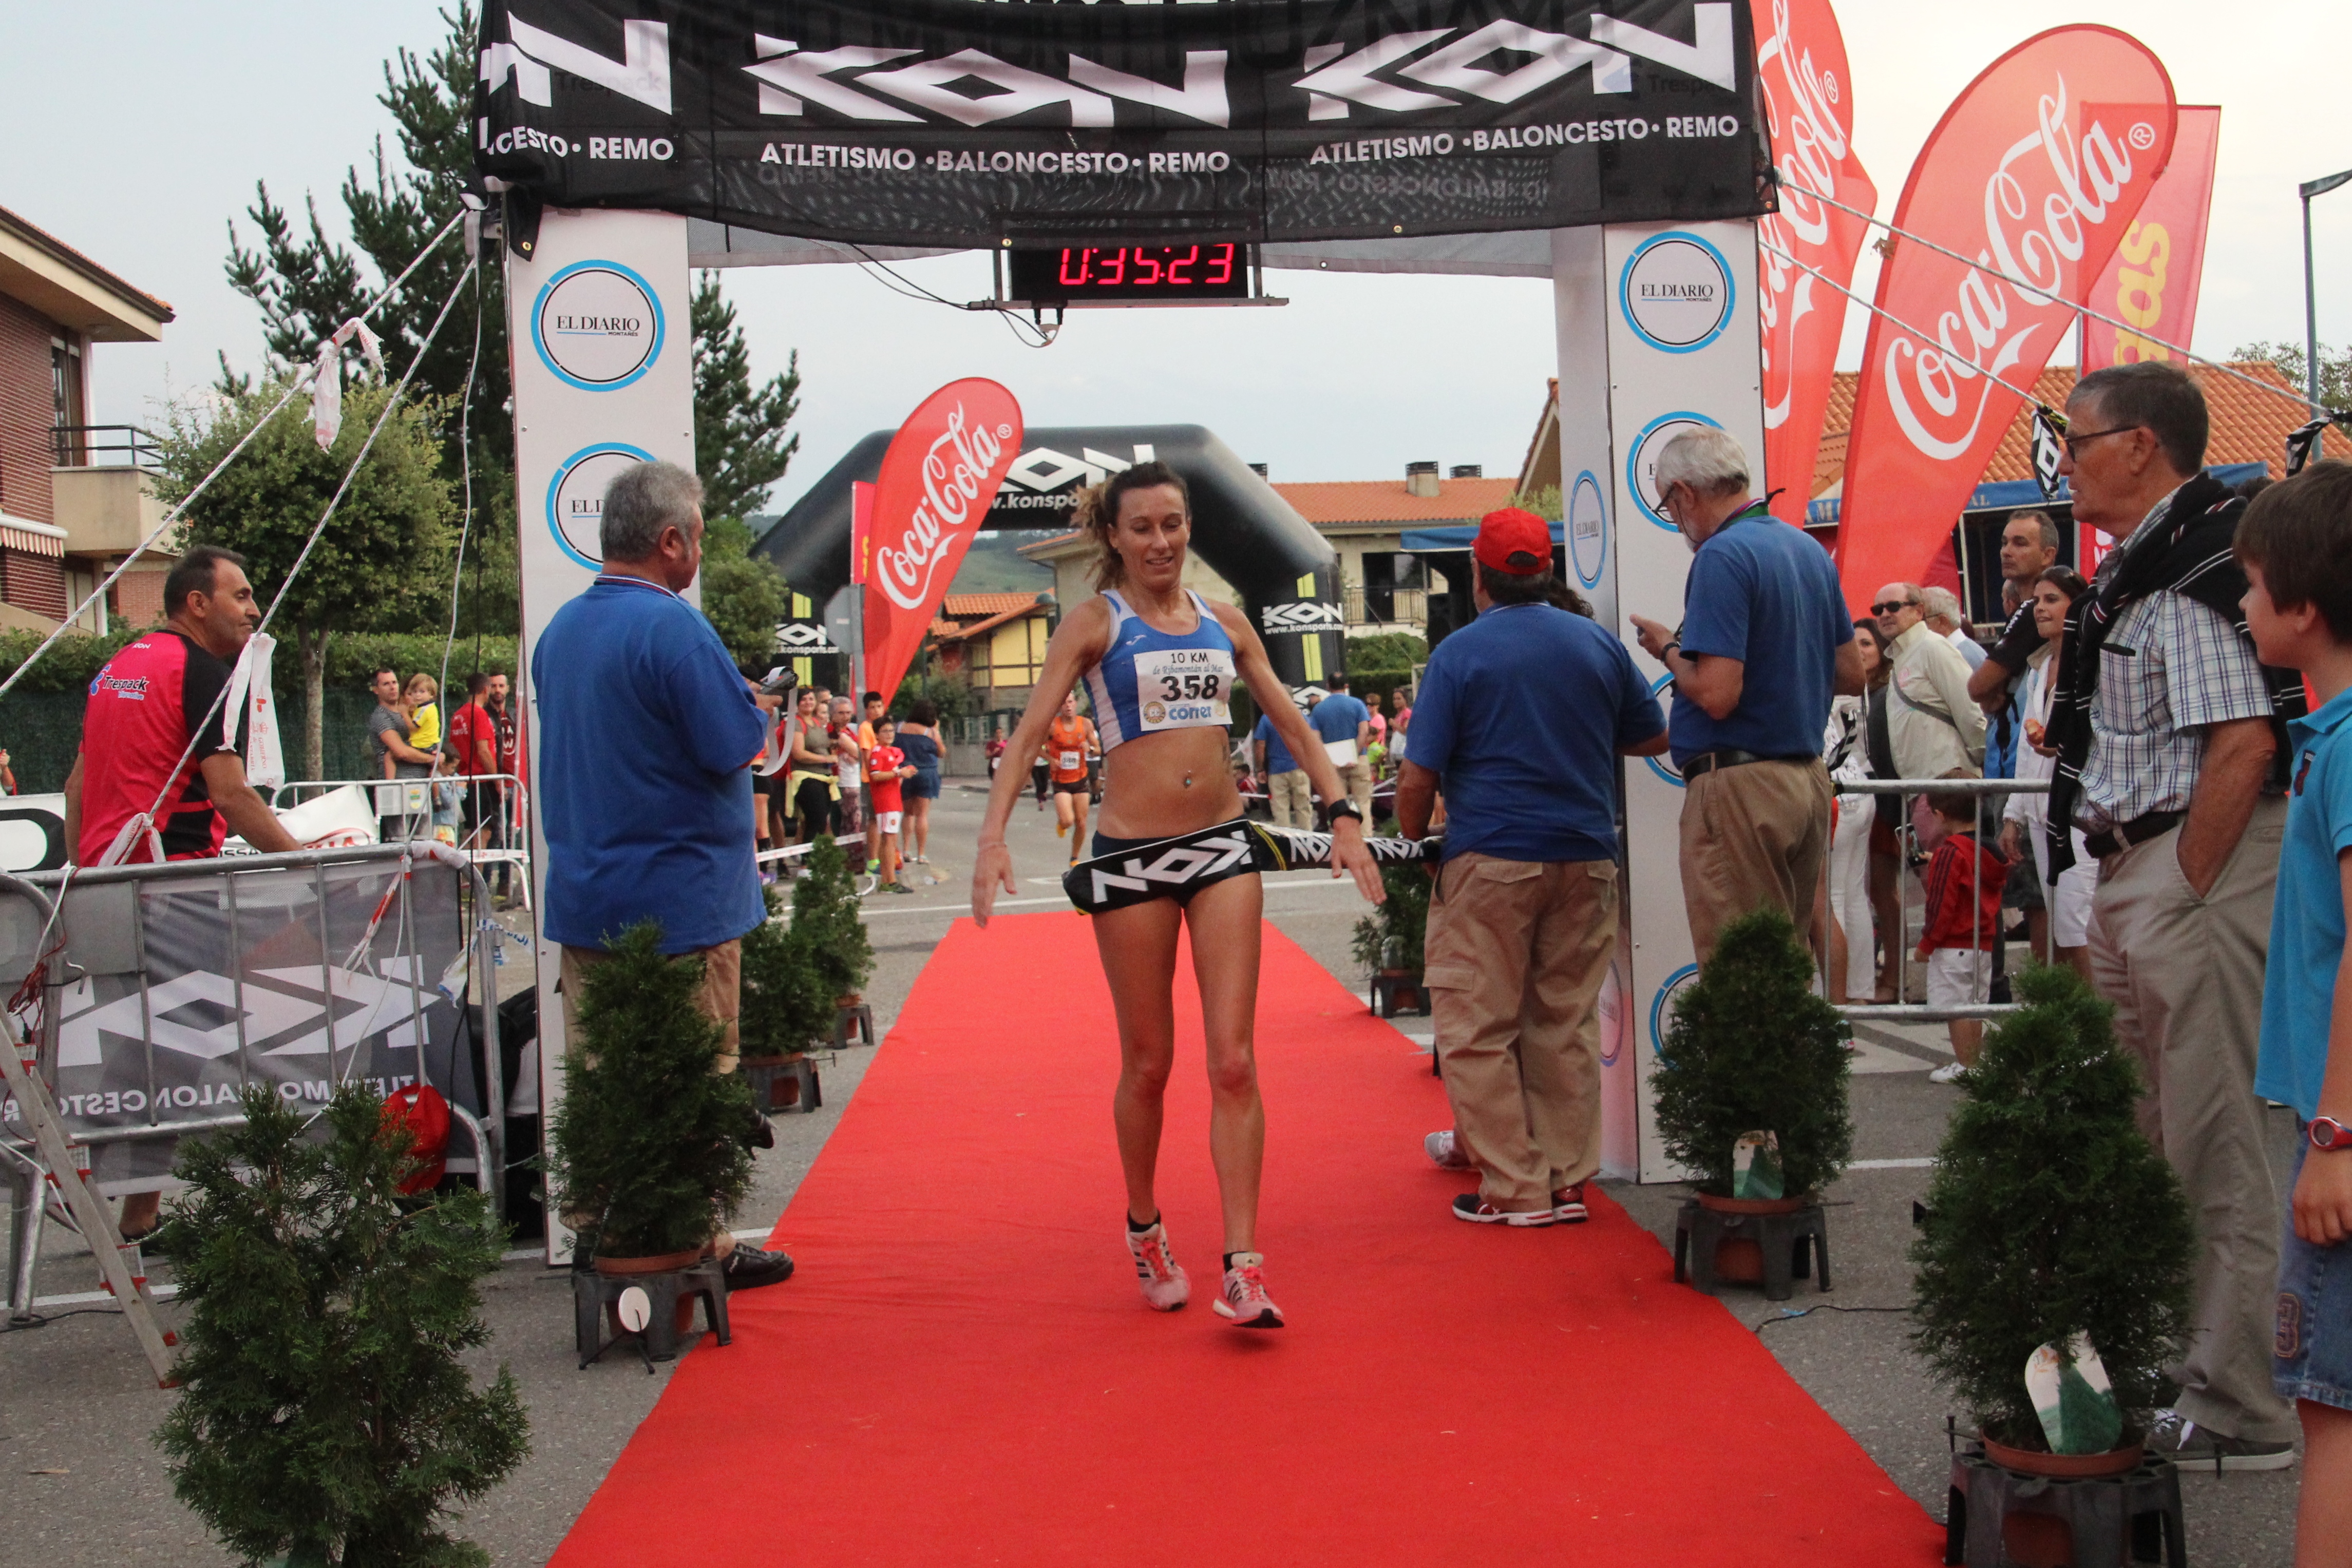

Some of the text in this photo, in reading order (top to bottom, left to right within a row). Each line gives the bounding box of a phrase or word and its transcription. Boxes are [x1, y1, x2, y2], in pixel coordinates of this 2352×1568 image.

[590, 137, 674, 160] REMO
[1310, 133, 1454, 165] ATLETISMO
[1666, 116, 1739, 138] REMO
[761, 143, 916, 170] ATLETISMO
[1149, 151, 1230, 173] REMO
[1641, 284, 1714, 297] EL DIARIO
[557, 316, 640, 331] EL DIARIO
[1171, 653, 1208, 663] 10 KM
[103, 675, 150, 692] Trespack
[1160, 675, 1219, 702] 358
